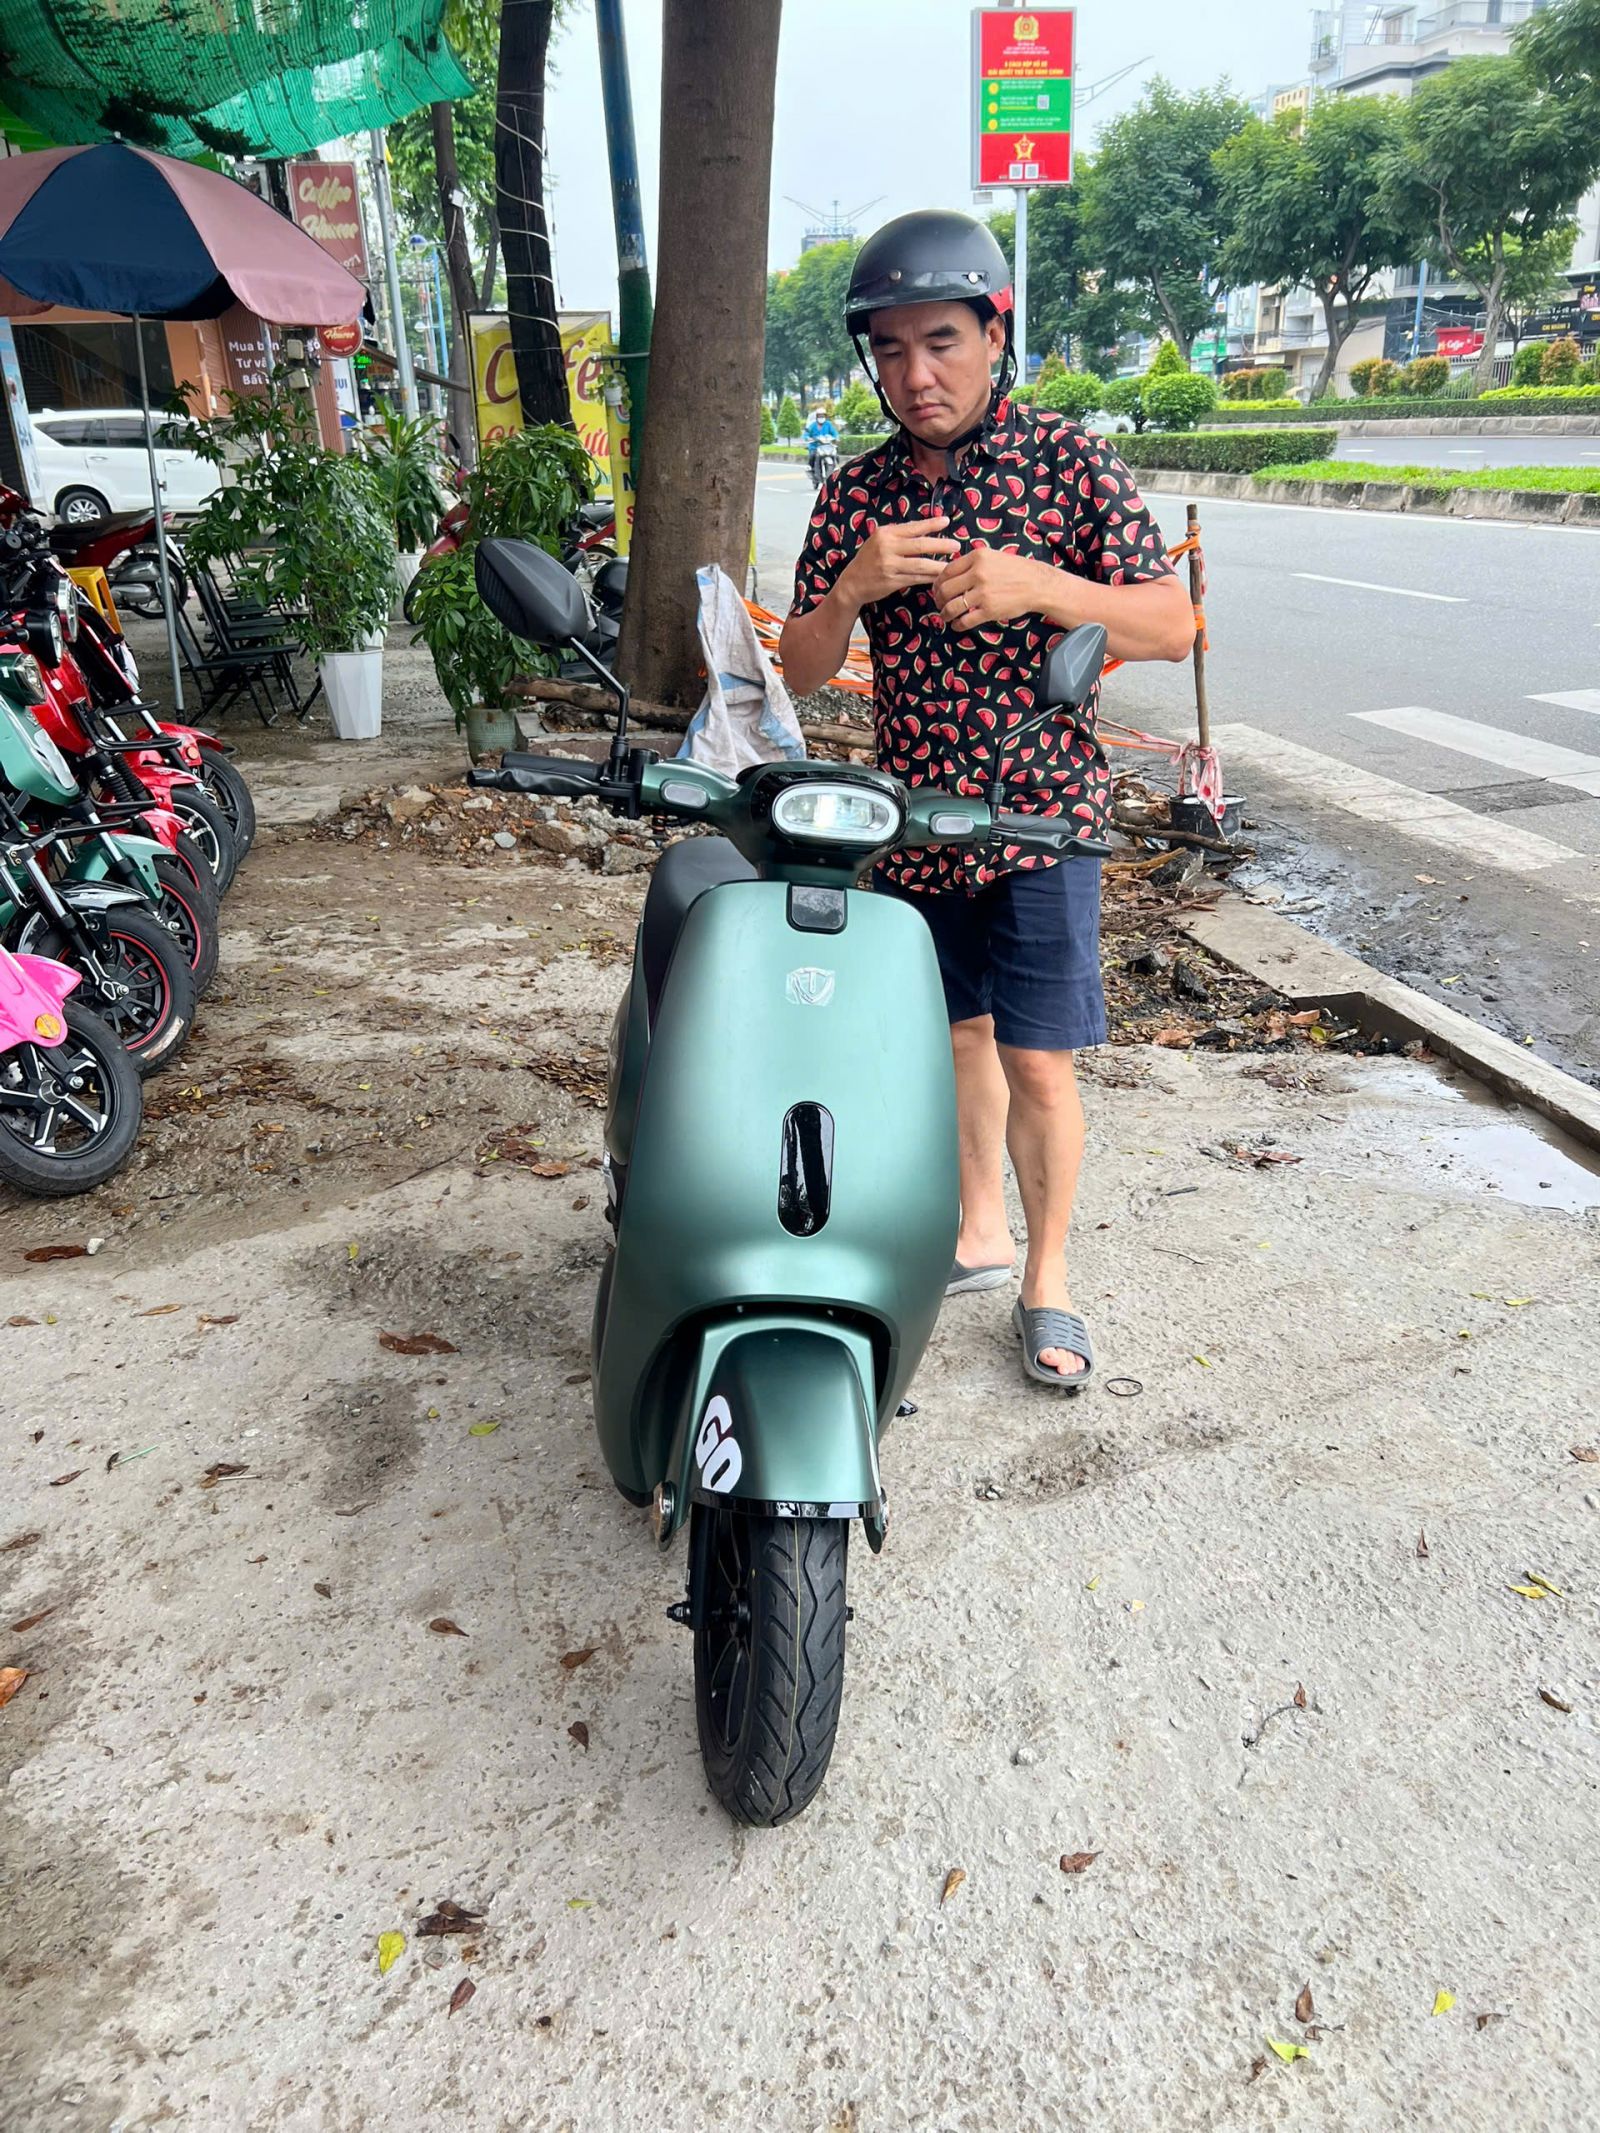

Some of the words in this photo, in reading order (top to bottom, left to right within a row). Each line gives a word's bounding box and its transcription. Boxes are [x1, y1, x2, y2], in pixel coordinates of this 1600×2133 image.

[298, 176, 352, 209] Coffee
[228, 341, 254, 351] Mua
[256, 341, 280, 351] bn
[235, 358, 251, 369] Tư
[242, 373, 263, 385] Bất
